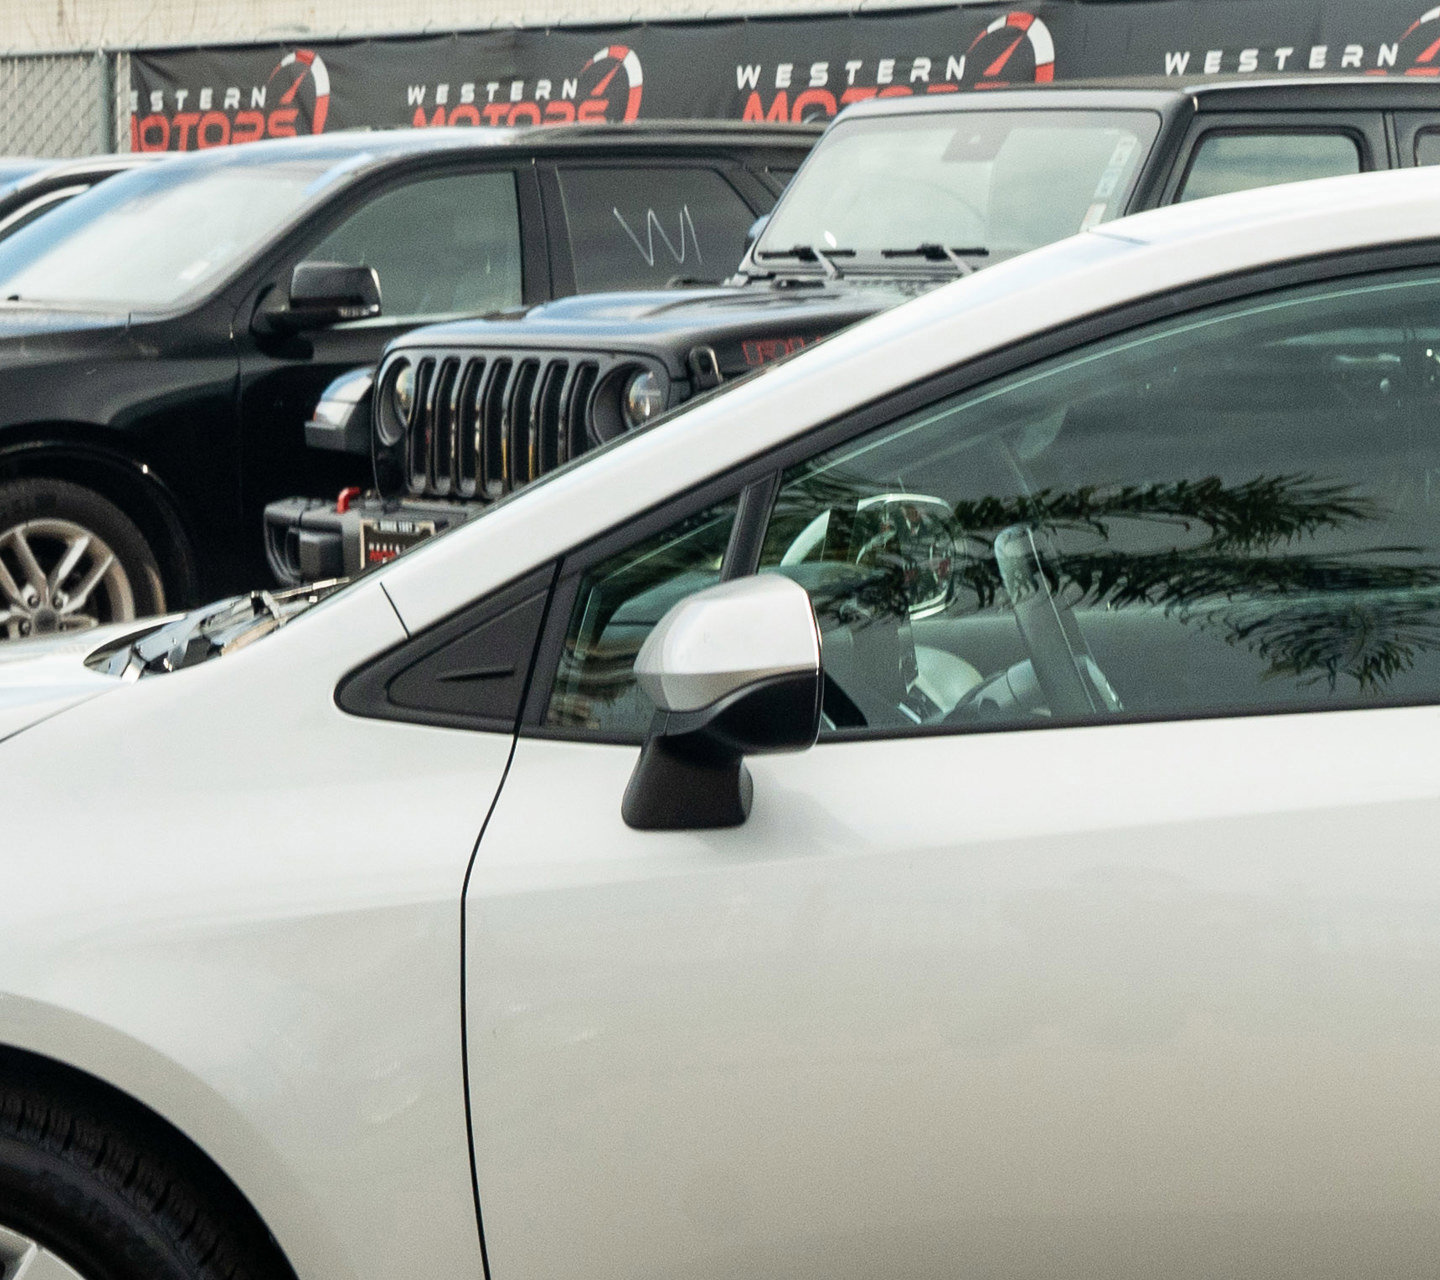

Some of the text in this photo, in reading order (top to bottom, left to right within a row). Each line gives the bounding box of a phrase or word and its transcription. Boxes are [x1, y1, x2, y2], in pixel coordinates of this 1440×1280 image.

[736, 55, 966, 89] WESTERN
[1164, 43, 1398, 76] WESTERN
[408, 78, 578, 106] WESTERN
[131, 108, 299, 153] OTORS
